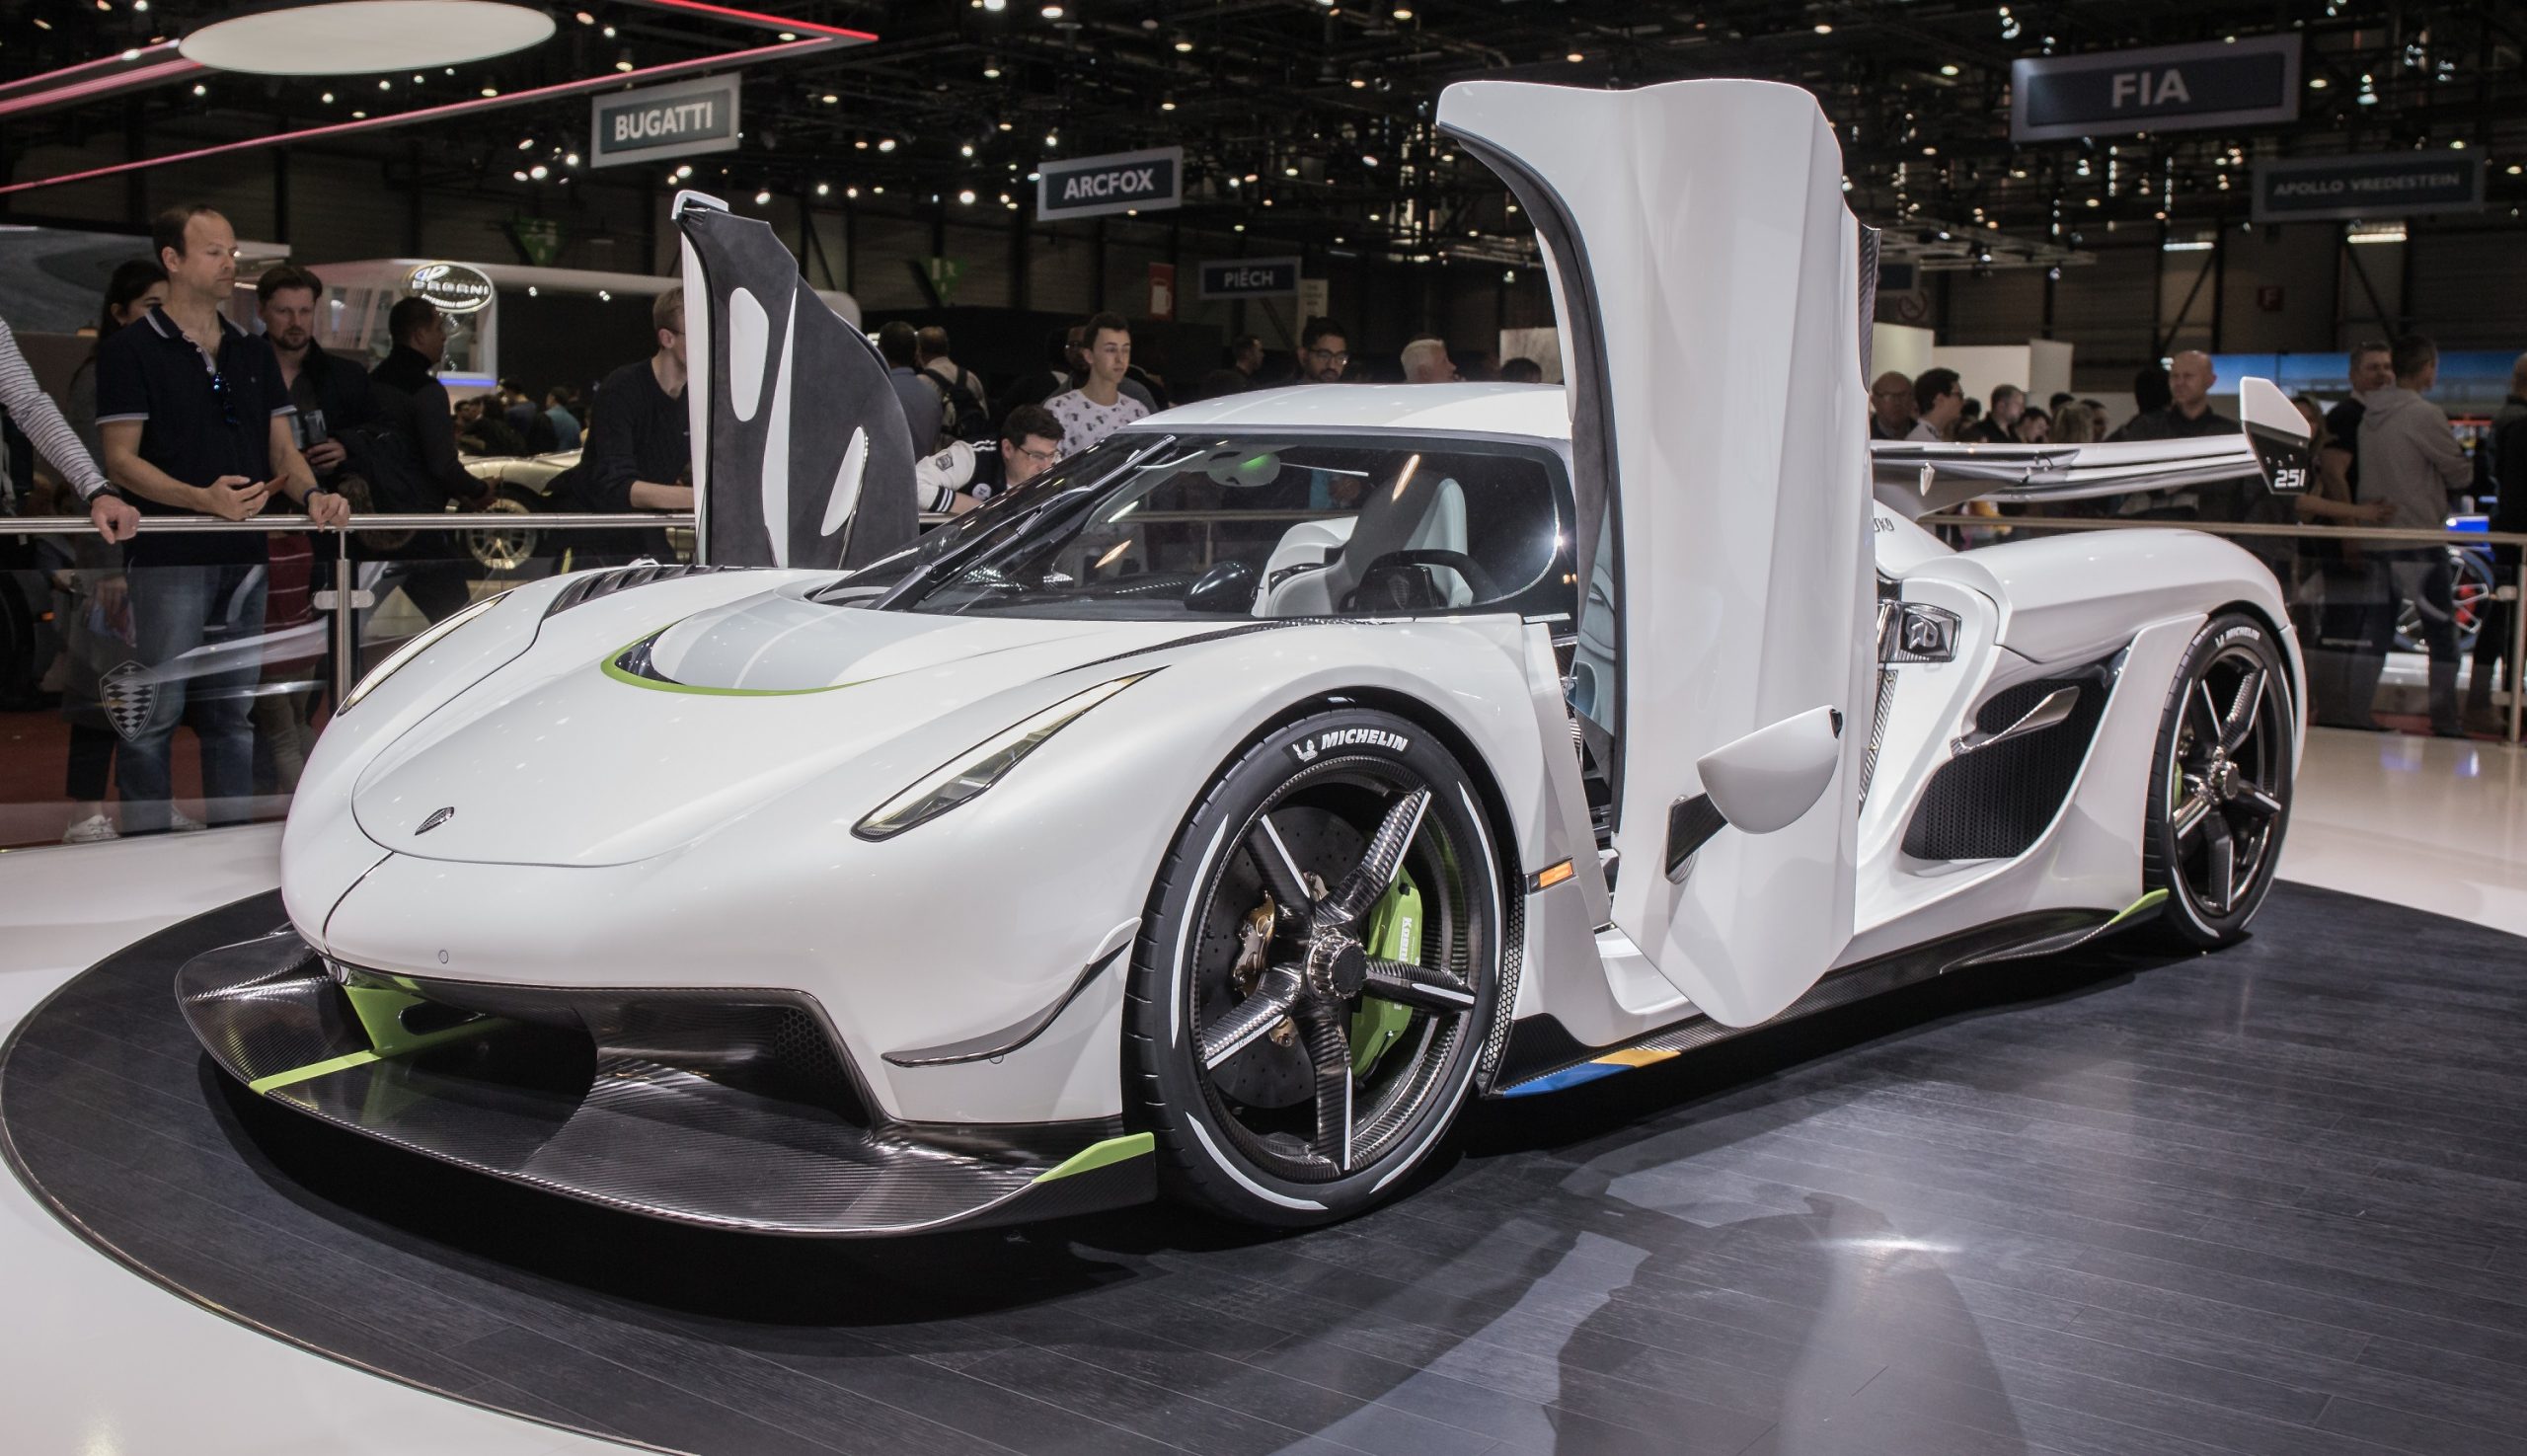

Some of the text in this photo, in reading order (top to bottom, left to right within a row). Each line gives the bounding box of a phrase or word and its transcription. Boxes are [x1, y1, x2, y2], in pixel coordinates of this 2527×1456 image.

[2111, 68, 2191, 109] FIA
[614, 101, 713, 142] BUGATTI
[1063, 168, 1154, 199] ARCFOX
[2274, 173, 2460, 195] APOLLO VREDESTEIN
[2226, 626, 2260, 641] MICHELIN
[1321, 728, 1408, 752] MICHELIN
